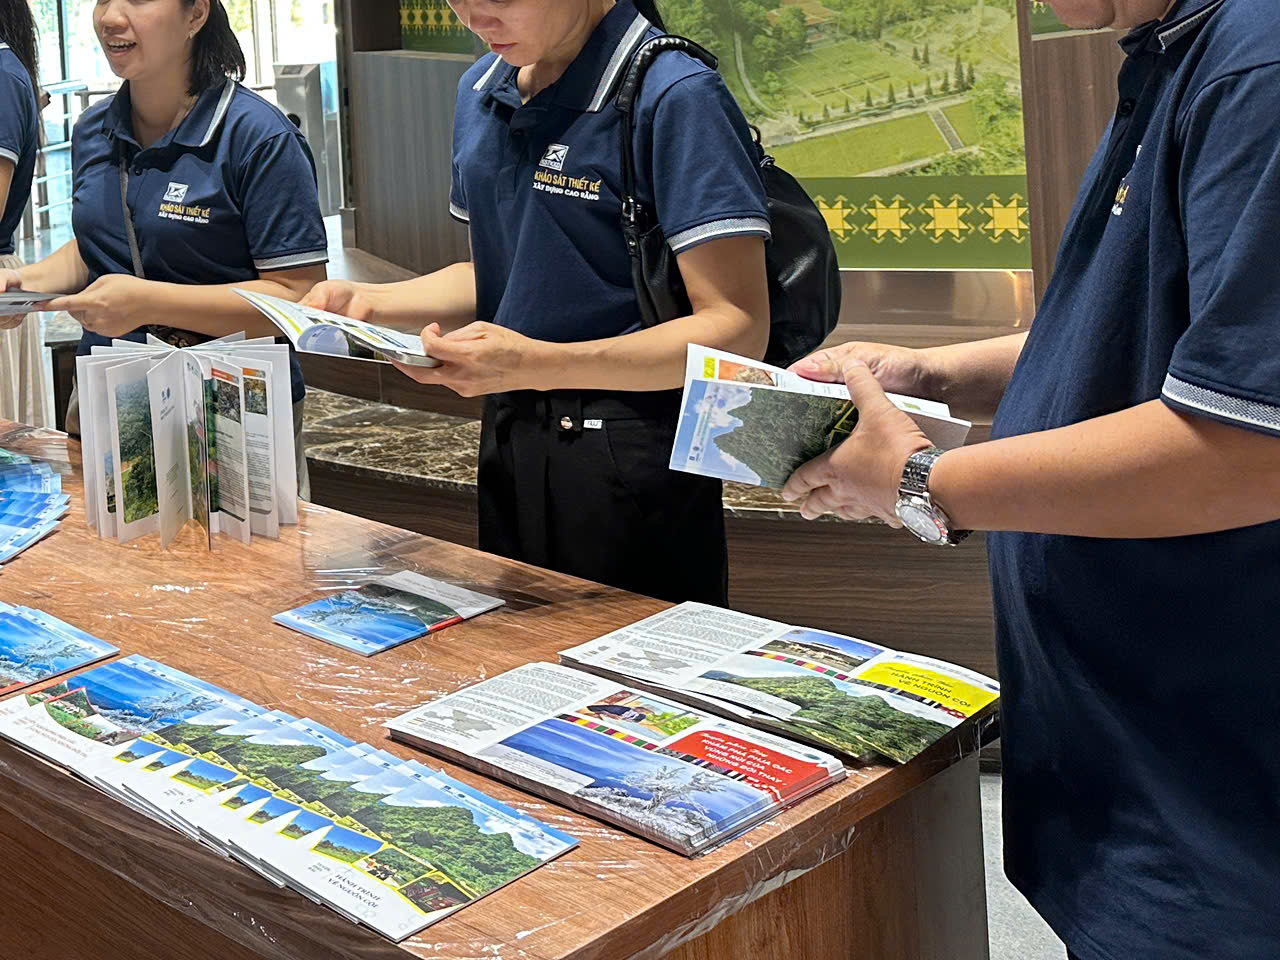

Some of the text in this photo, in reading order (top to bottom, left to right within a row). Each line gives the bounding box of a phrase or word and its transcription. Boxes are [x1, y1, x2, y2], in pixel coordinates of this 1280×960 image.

[534, 170, 601, 192] KHẢO SÁT THIẾT KẾ
[564, 189, 579, 197] CAO
